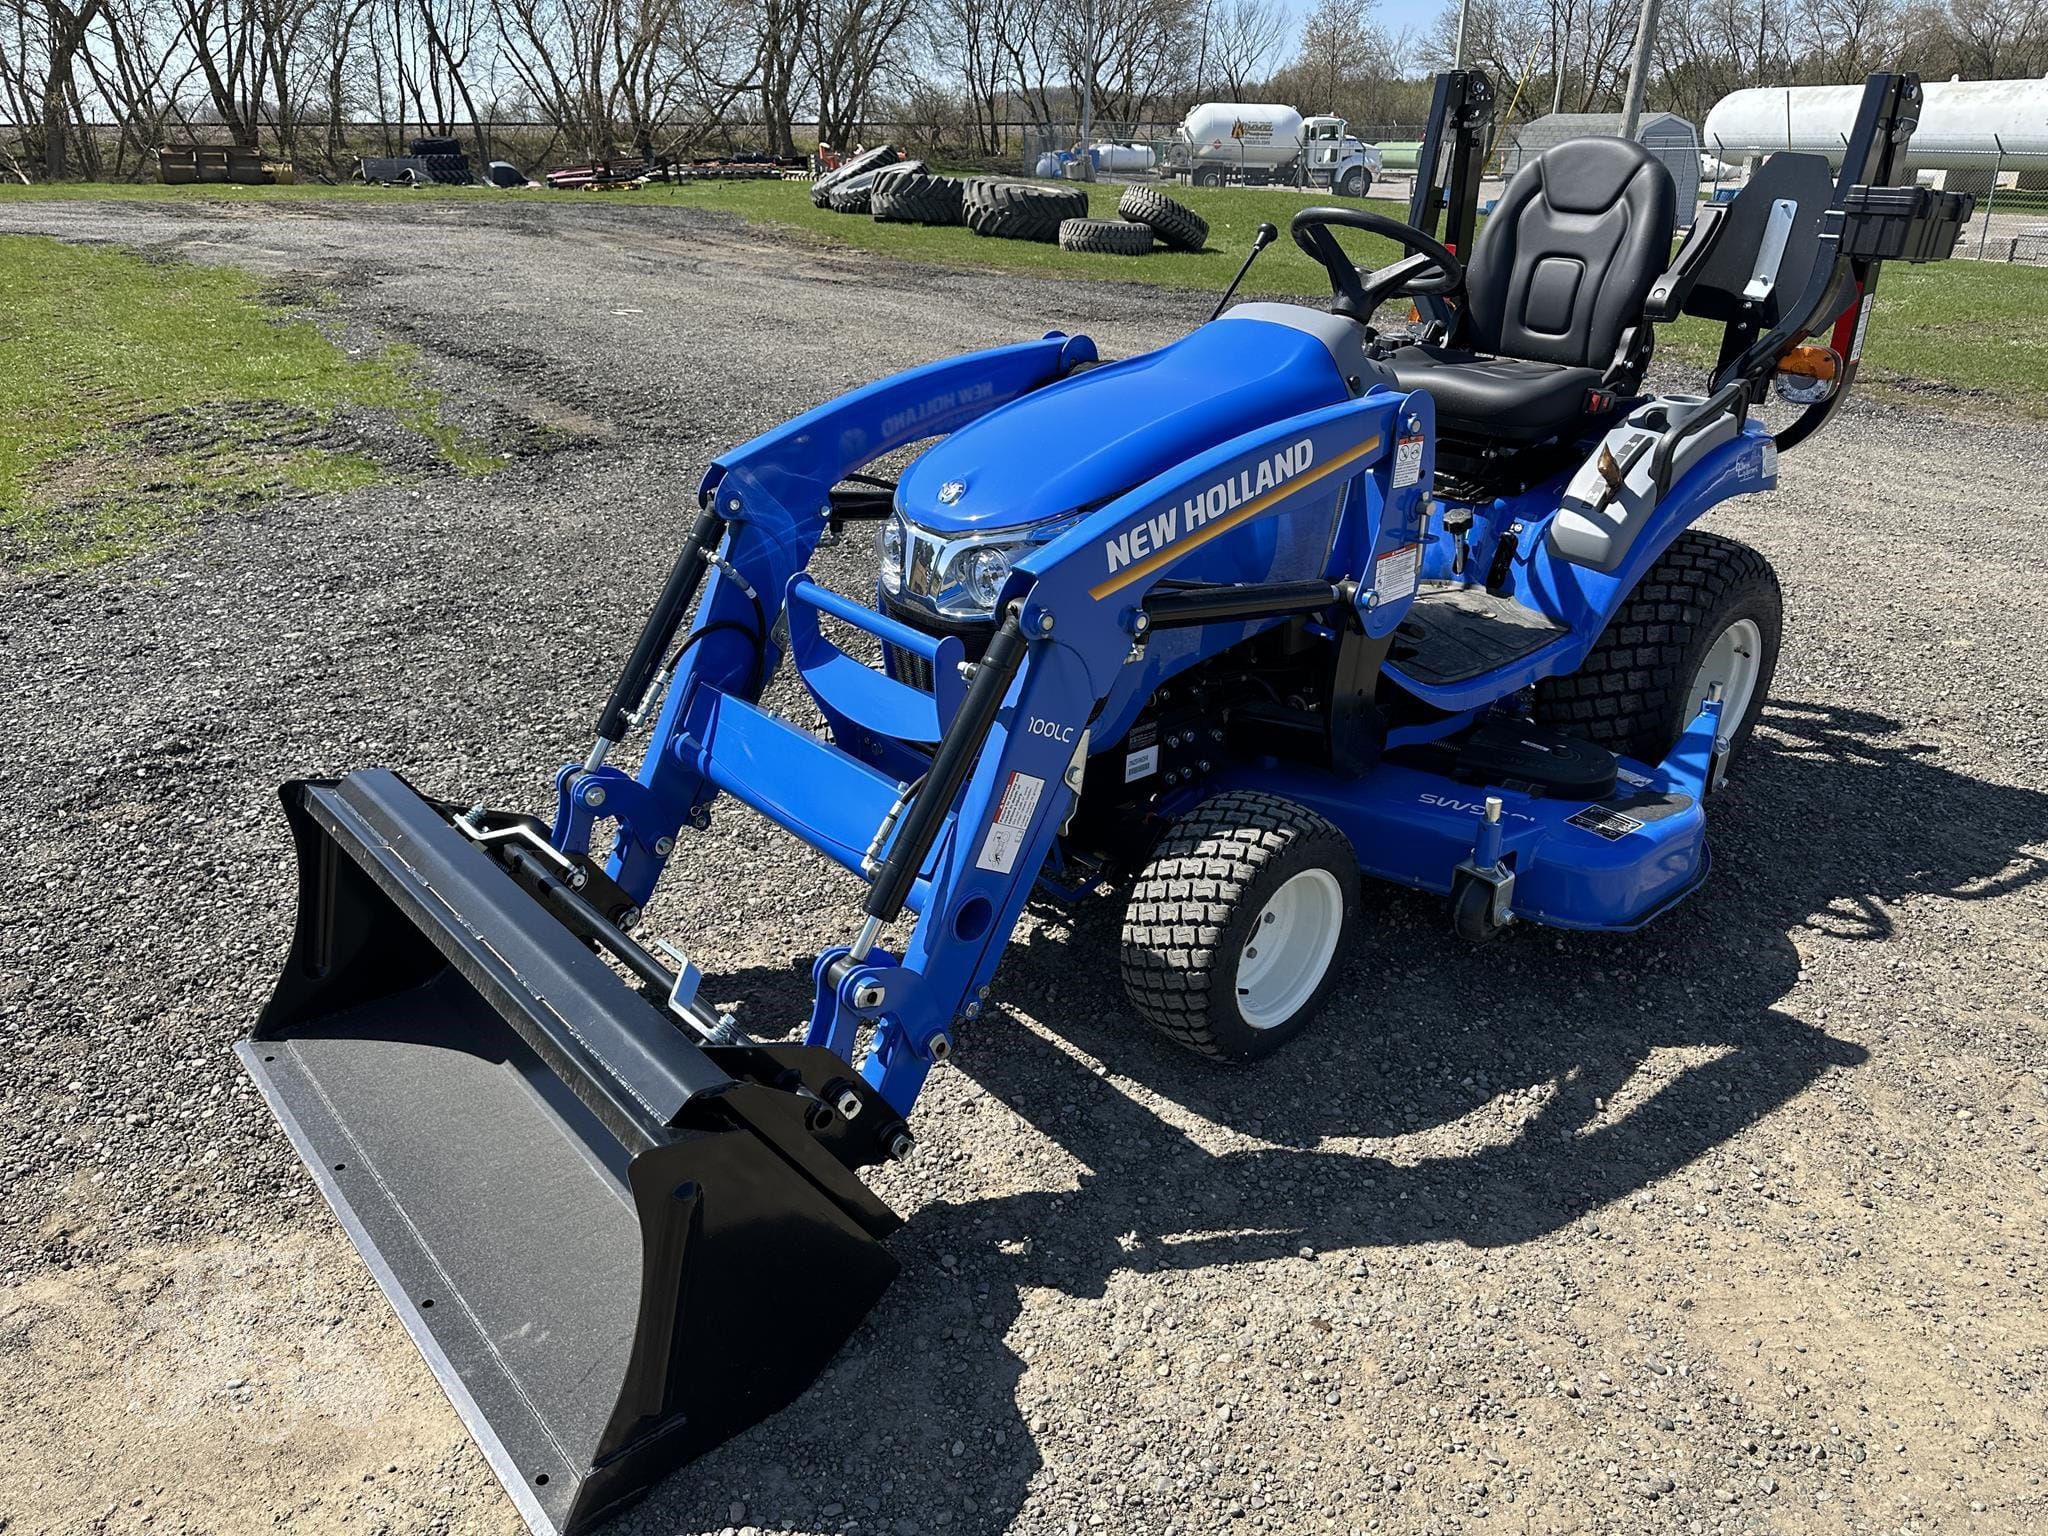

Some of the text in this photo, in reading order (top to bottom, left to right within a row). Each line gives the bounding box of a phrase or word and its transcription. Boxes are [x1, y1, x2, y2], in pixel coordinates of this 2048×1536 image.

[1105, 438, 1314, 574] NEW HOLLAND
[1027, 716, 1074, 743] 100LC
